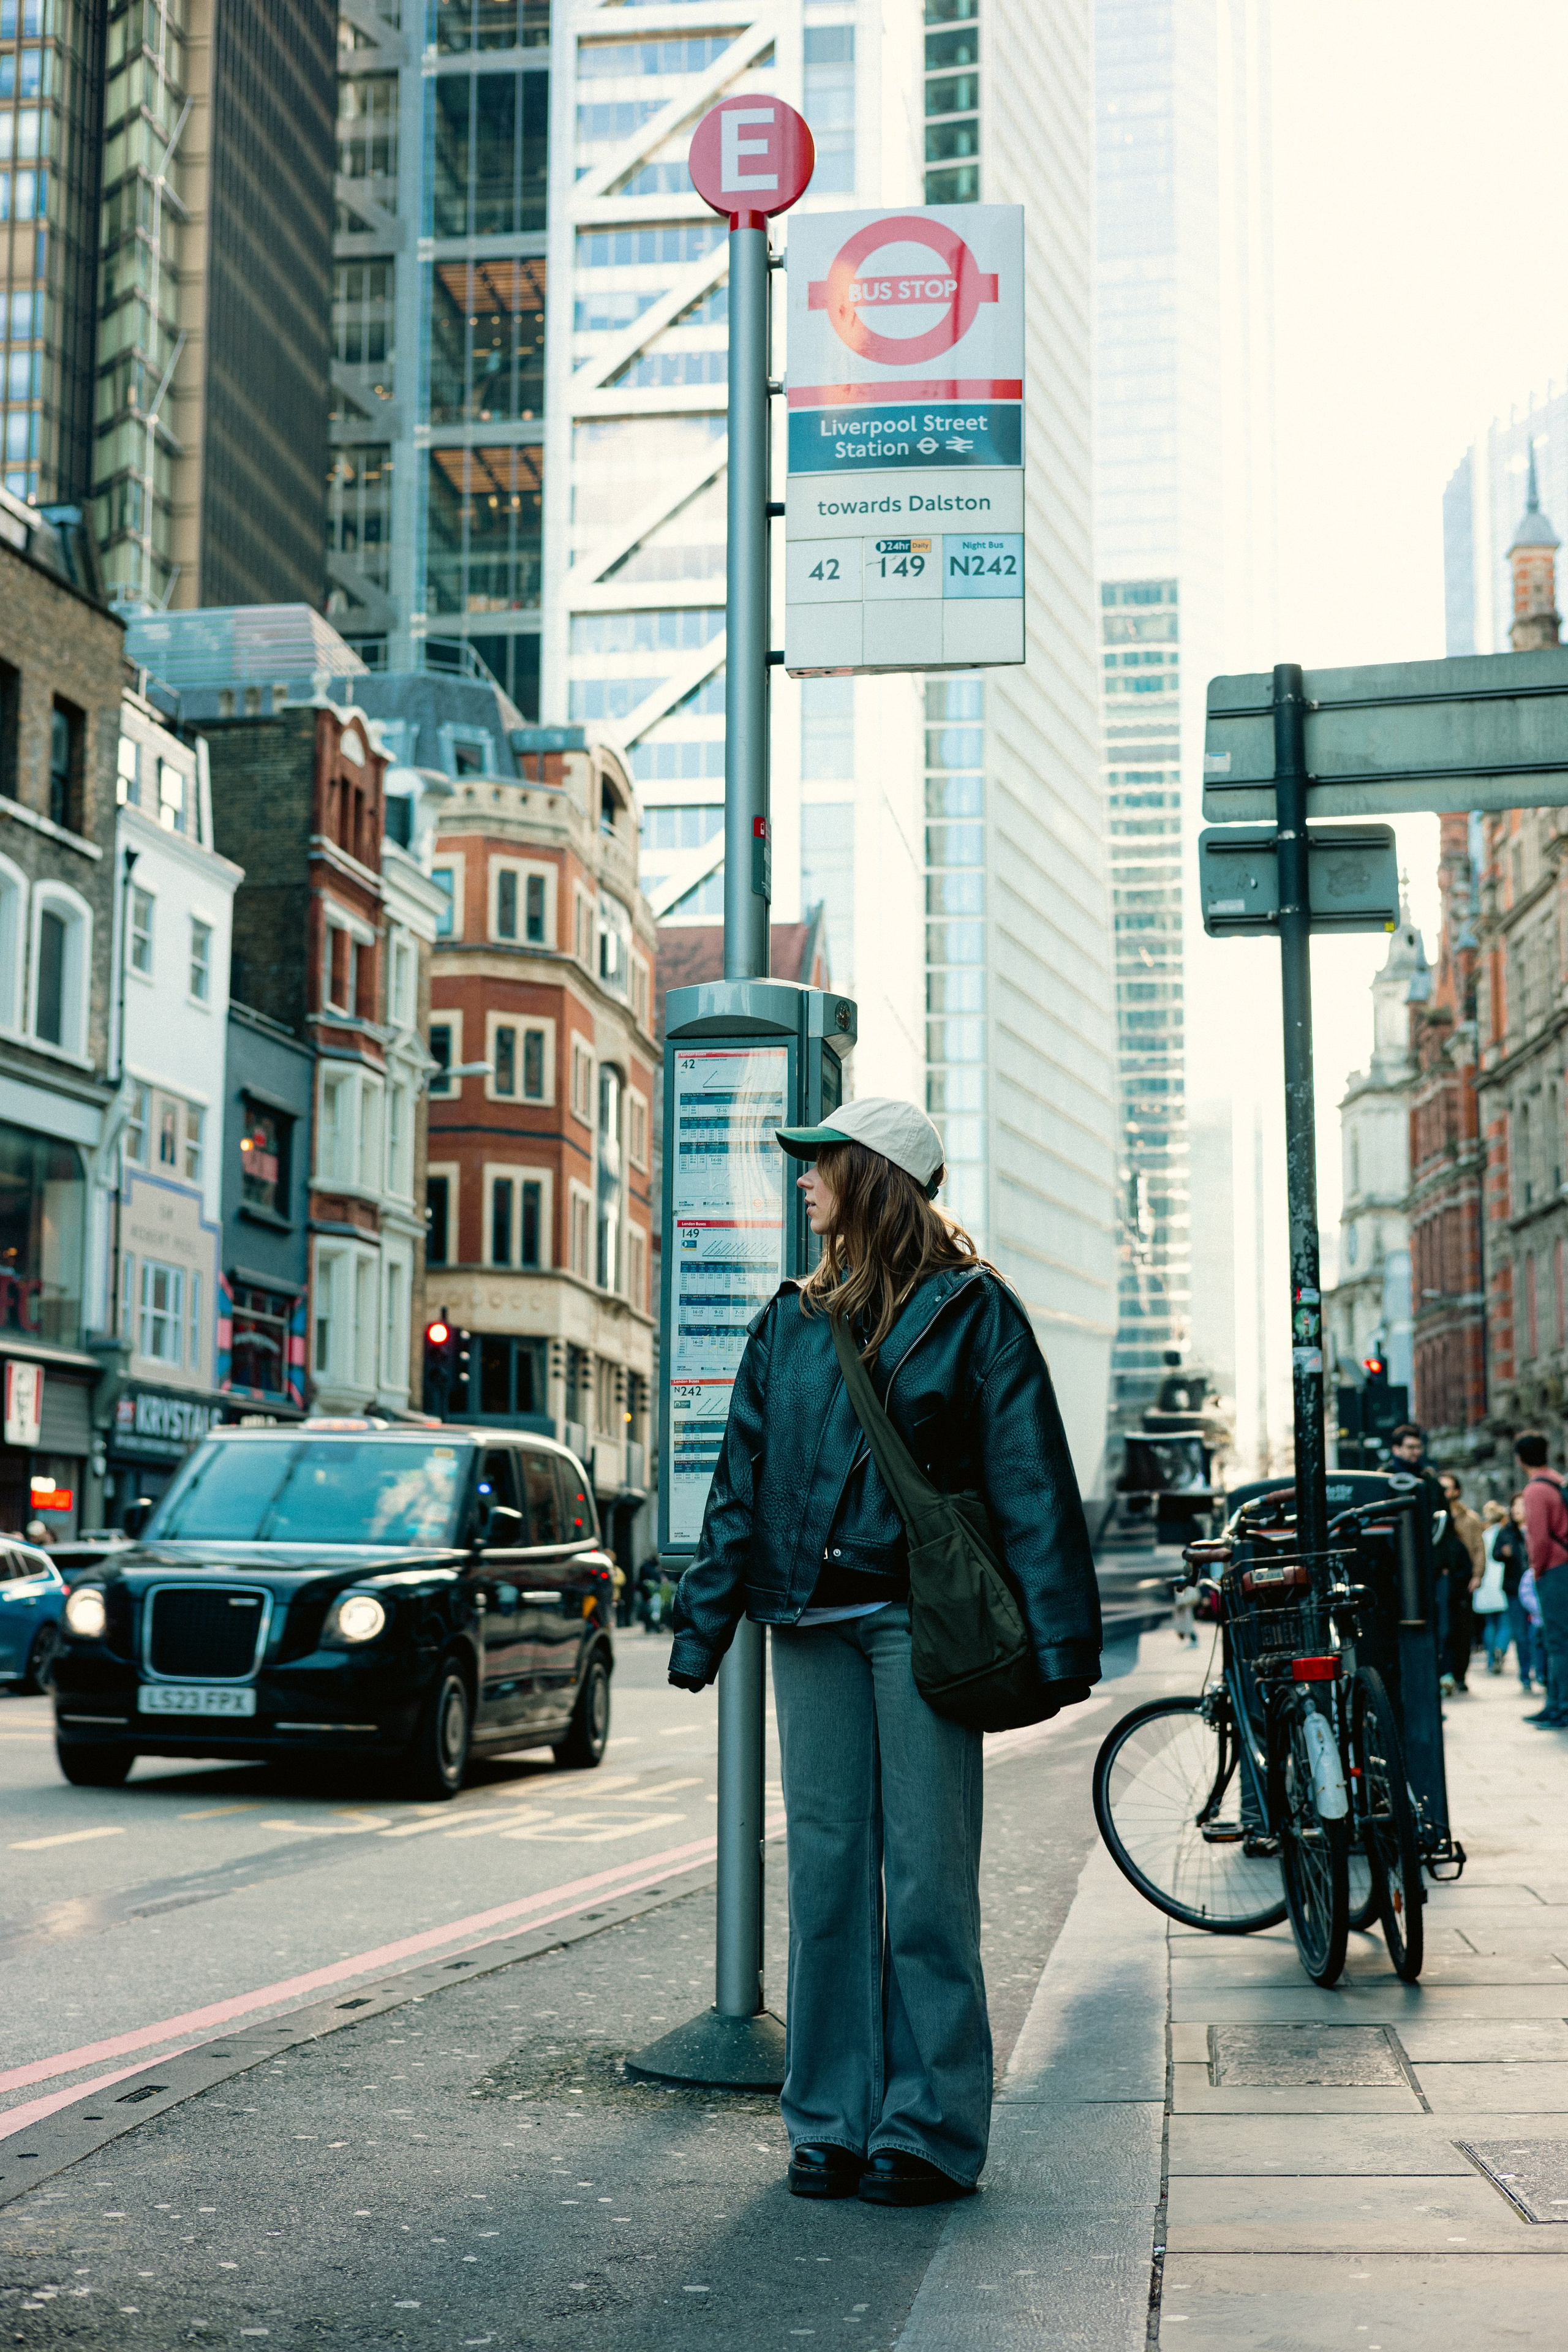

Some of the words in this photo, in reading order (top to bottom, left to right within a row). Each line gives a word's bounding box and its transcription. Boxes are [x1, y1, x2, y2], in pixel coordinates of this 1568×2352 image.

[720, 107, 778, 193] E
[848, 281, 892, 303] BUS
[898, 279, 958, 300] STOP
[820, 416, 917, 437] Liverpool
[923, 415, 988, 432] Street
[835, 441, 909, 459] Station
[817, 497, 902, 516] towards
[909, 494, 991, 512] Dalston
[888, 541, 910, 551] 24hr
[962, 541, 986, 550] Night
[809, 559, 840, 581] 42
[881, 555, 925, 578] 149
[950, 555, 1017, 576] N242
[681, 1058, 695, 1069] 42
[682, 1229, 699, 1238] 149
[674, 1386, 701, 1396] N242
